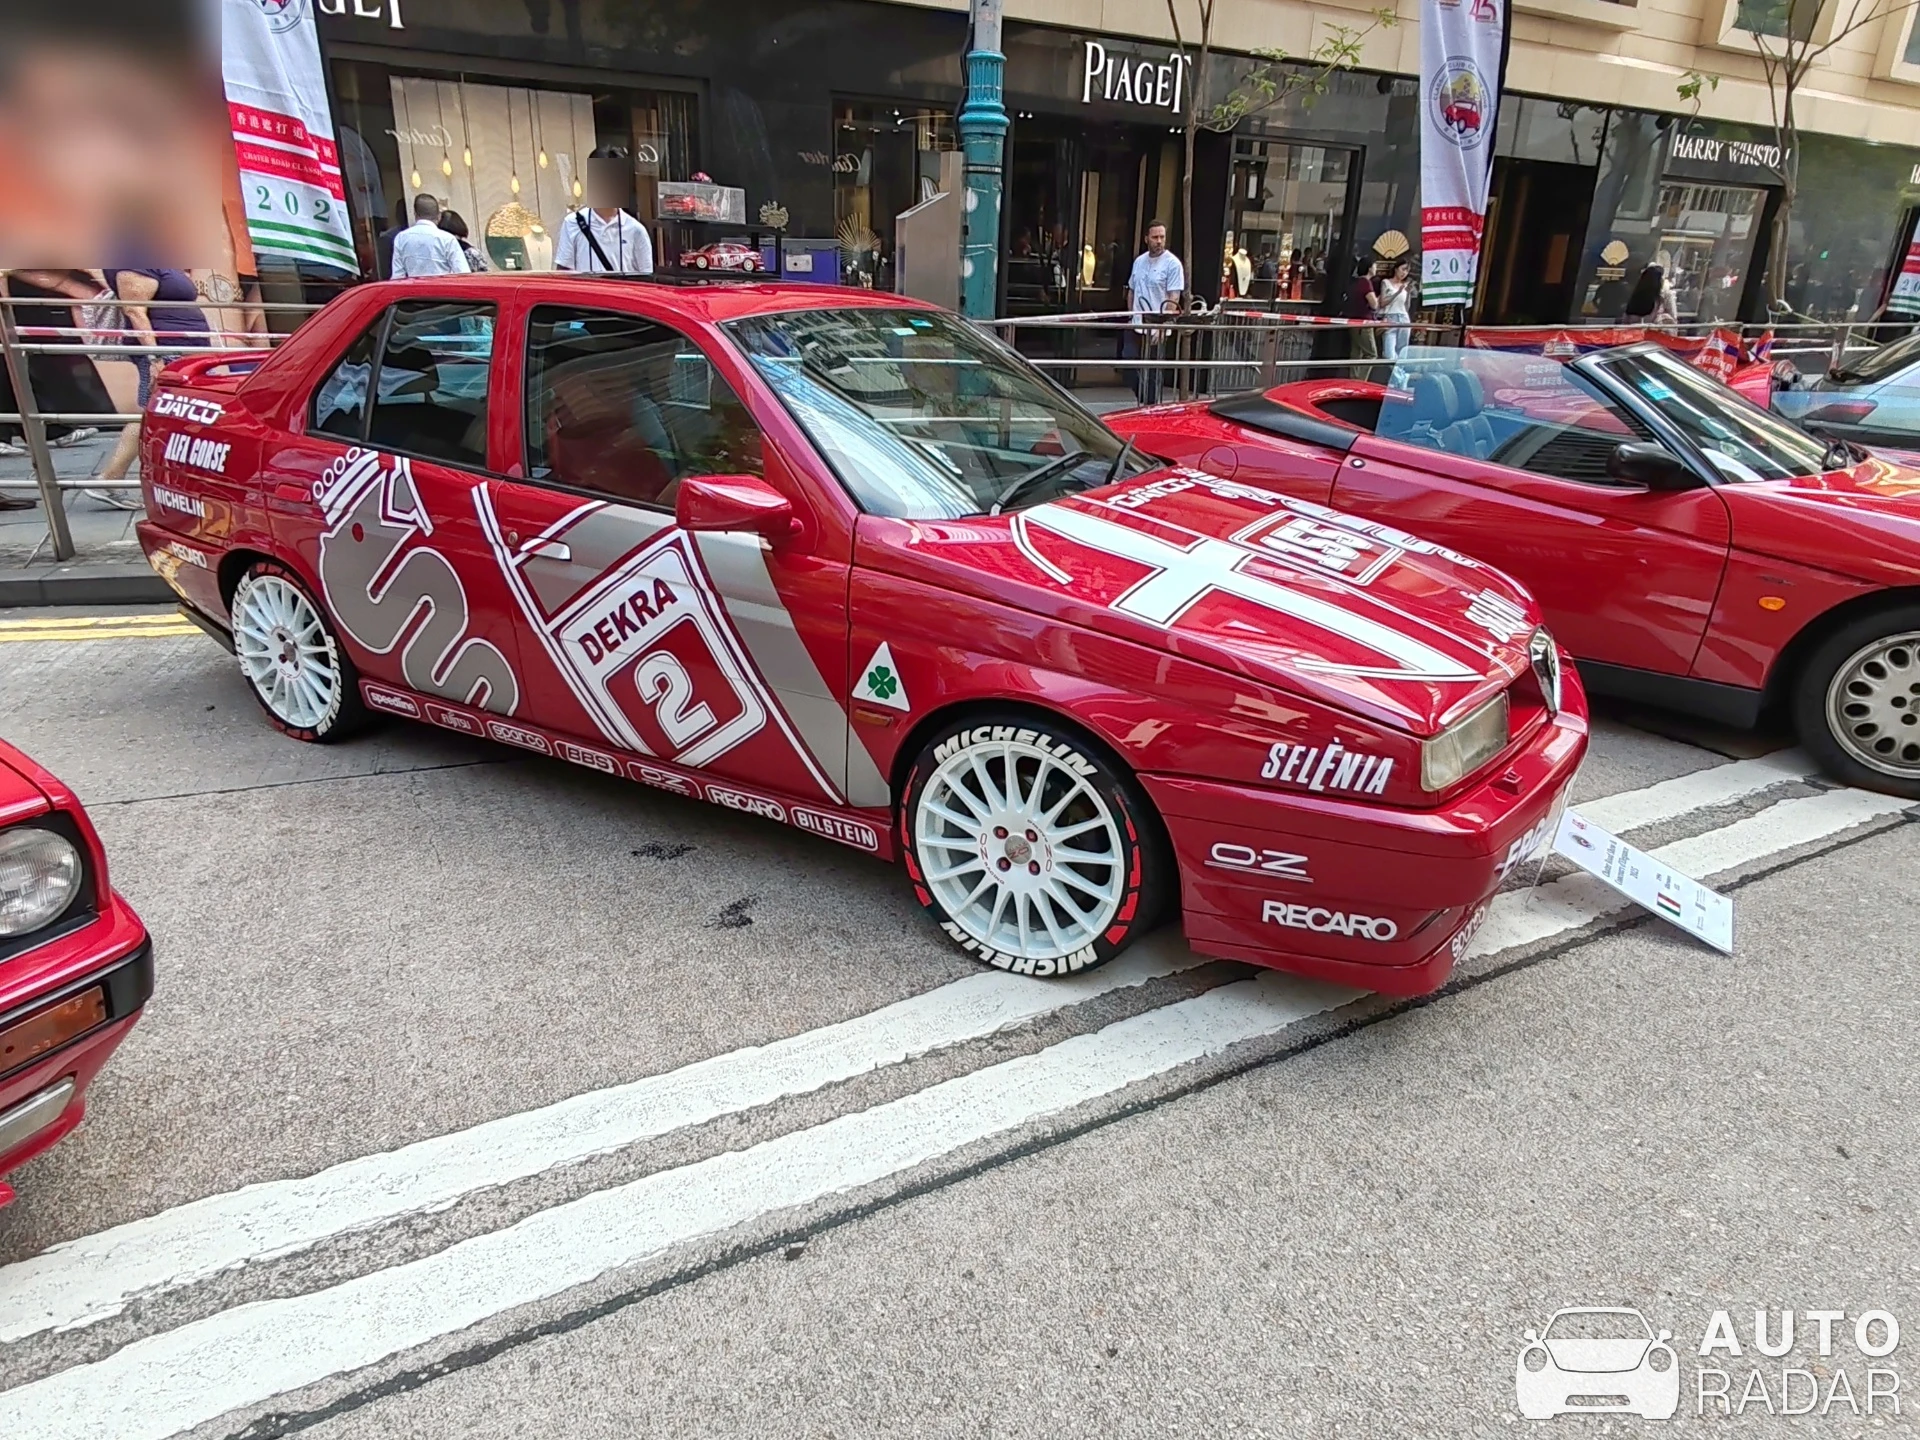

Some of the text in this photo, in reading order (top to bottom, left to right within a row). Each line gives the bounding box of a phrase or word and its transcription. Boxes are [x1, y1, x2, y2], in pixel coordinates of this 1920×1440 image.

[1082, 42, 1192, 113] PIAGET
[1672, 134, 1724, 163] HARRY
[155, 392, 226, 425] DAYCO
[164, 432, 231, 472] ALFA CORSE
[153, 486, 206, 518] MICHELIN
[171, 540, 208, 570] RECARO
[577, 577, 679, 666] DEKRA
[315, 635, 342, 737] MICHELIN
[370, 691, 416, 714] speedline
[634, 650, 719, 750] 2
[492, 724, 547, 752] sparco
[933, 725, 1098, 777] MICHELIN
[567, 745, 614, 773] BBS
[1260, 736, 1394, 795] SELÈNIA
[710, 787, 785, 822] RECARO
[796, 810, 876, 847] BILSTEIN
[1262, 899, 1398, 941] RECARO
[939, 920, 1098, 977] MICHELIN
